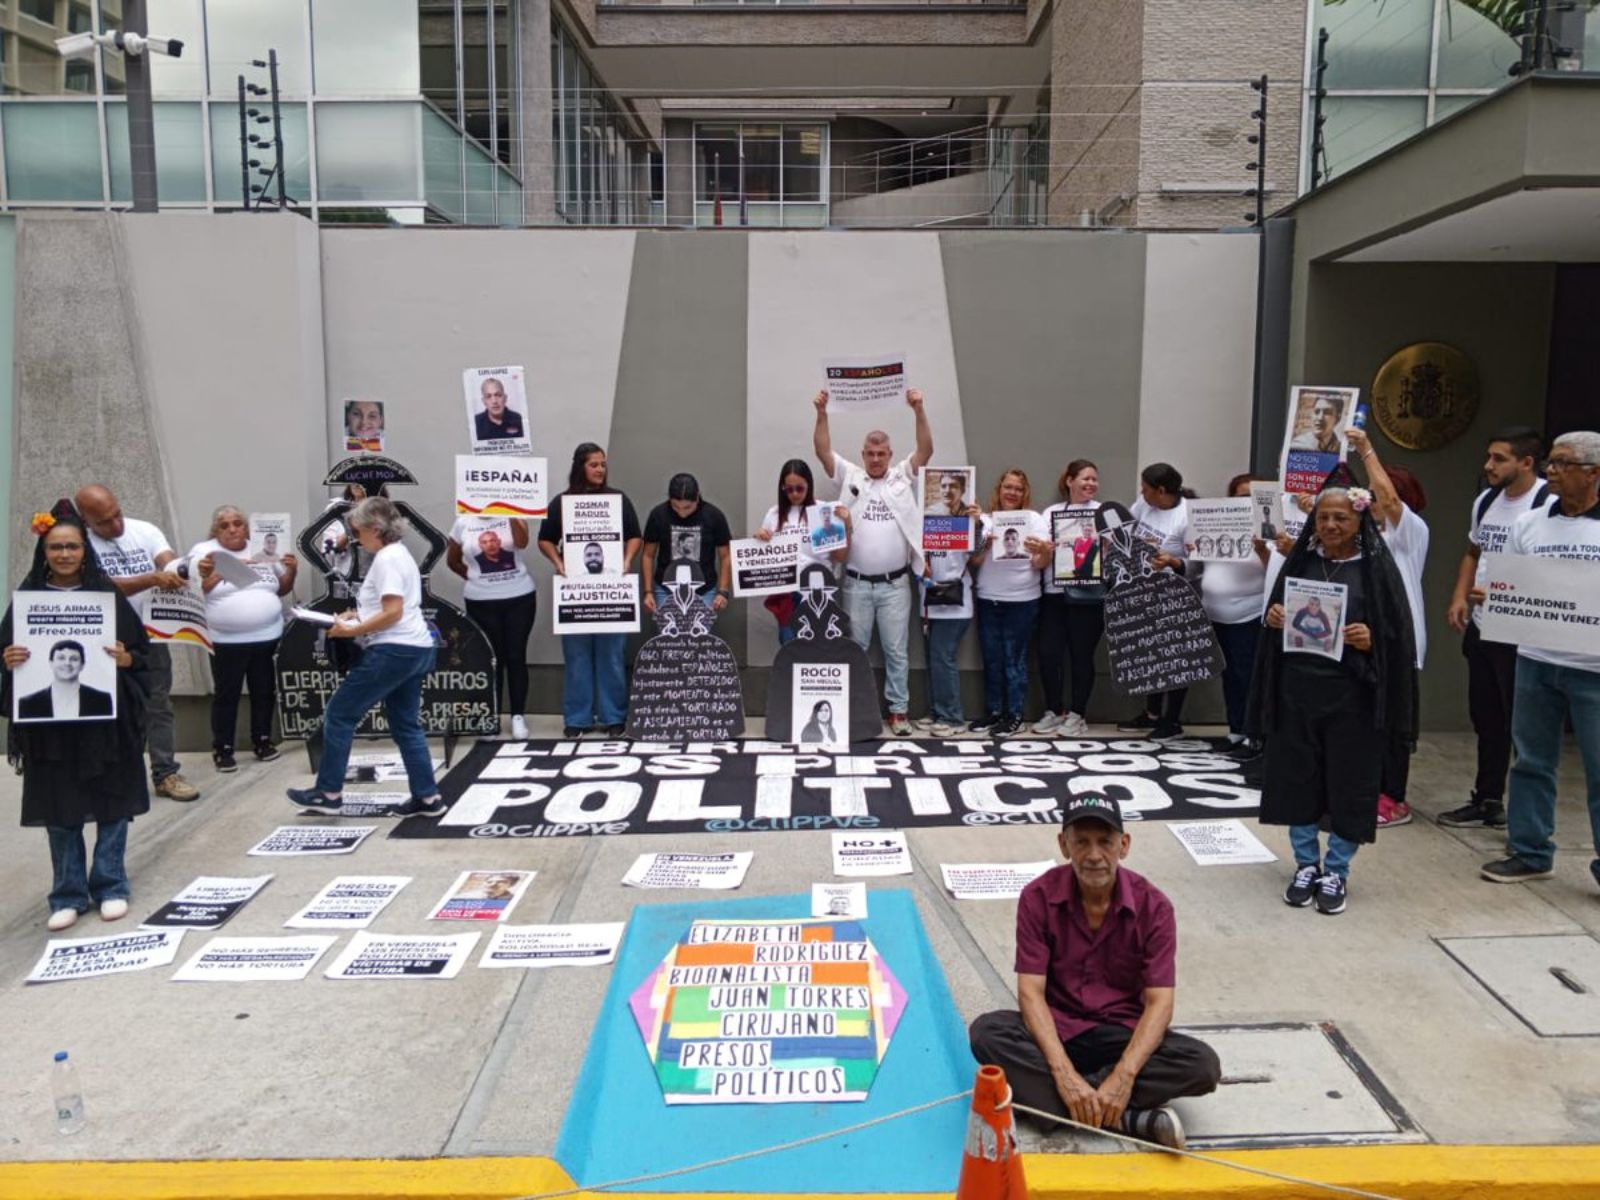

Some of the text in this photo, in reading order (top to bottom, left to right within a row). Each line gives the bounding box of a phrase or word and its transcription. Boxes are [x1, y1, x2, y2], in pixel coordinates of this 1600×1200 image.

[828, 369, 841, 377] 20
[465, 470, 538, 483] ¡ESPAÑA!
[736, 543, 798, 558] ESPAÑOLES
[1534, 544, 1570, 553] LIBEREN
[746, 555, 797, 567] VENEZOLANOS
[1490, 582, 1507, 590] NO
[1489, 593, 1577, 610] DESAPARIONES
[1488, 605, 1541, 618] FORZADA
[1544, 611, 1559, 621] EN
[29, 627, 102, 635] #FreeJesus
[682, 660, 734, 673] ESPAÑOLES
[801, 665, 841, 677] ROCÍO
[1168, 667, 1211, 684] TORTURA
[286, 692, 310, 709] DE
[663, 688, 710, 699] MOMENTO
[432, 702, 490, 717] PRESAS
[682, 702, 737, 713] TORTURADO
[644, 715, 710, 727] AISLAMIENTO
[687, 728, 730, 739] TORTURA
[495, 740, 1213, 756] LIBEREN A TODOS
[478, 752, 1241, 779] LOS PRESOS
[843, 840, 874, 848] NO
[691, 925, 801, 943] ELIZABETH
[49, 941, 169, 965] ES UN CRIMEN
[52, 934, 161, 957] LA TORTURA
[755, 940, 868, 962] RODRÍGUEZ
[40, 957, 149, 978] HUMANIDAD
[45, 956, 116, 972] DE LESA
[249, 961, 305, 969] TORTURA
[413, 959, 432, 967] DE
[346, 967, 405, 975] TORTURA
[669, 965, 810, 985] BIOANALISTA
[710, 985, 869, 1009] JUAN TORRES
[722, 1012, 834, 1037] CIRUJANO
[682, 1041, 770, 1068] PRESOS
[714, 1066, 845, 1096] POLÍTICOS
